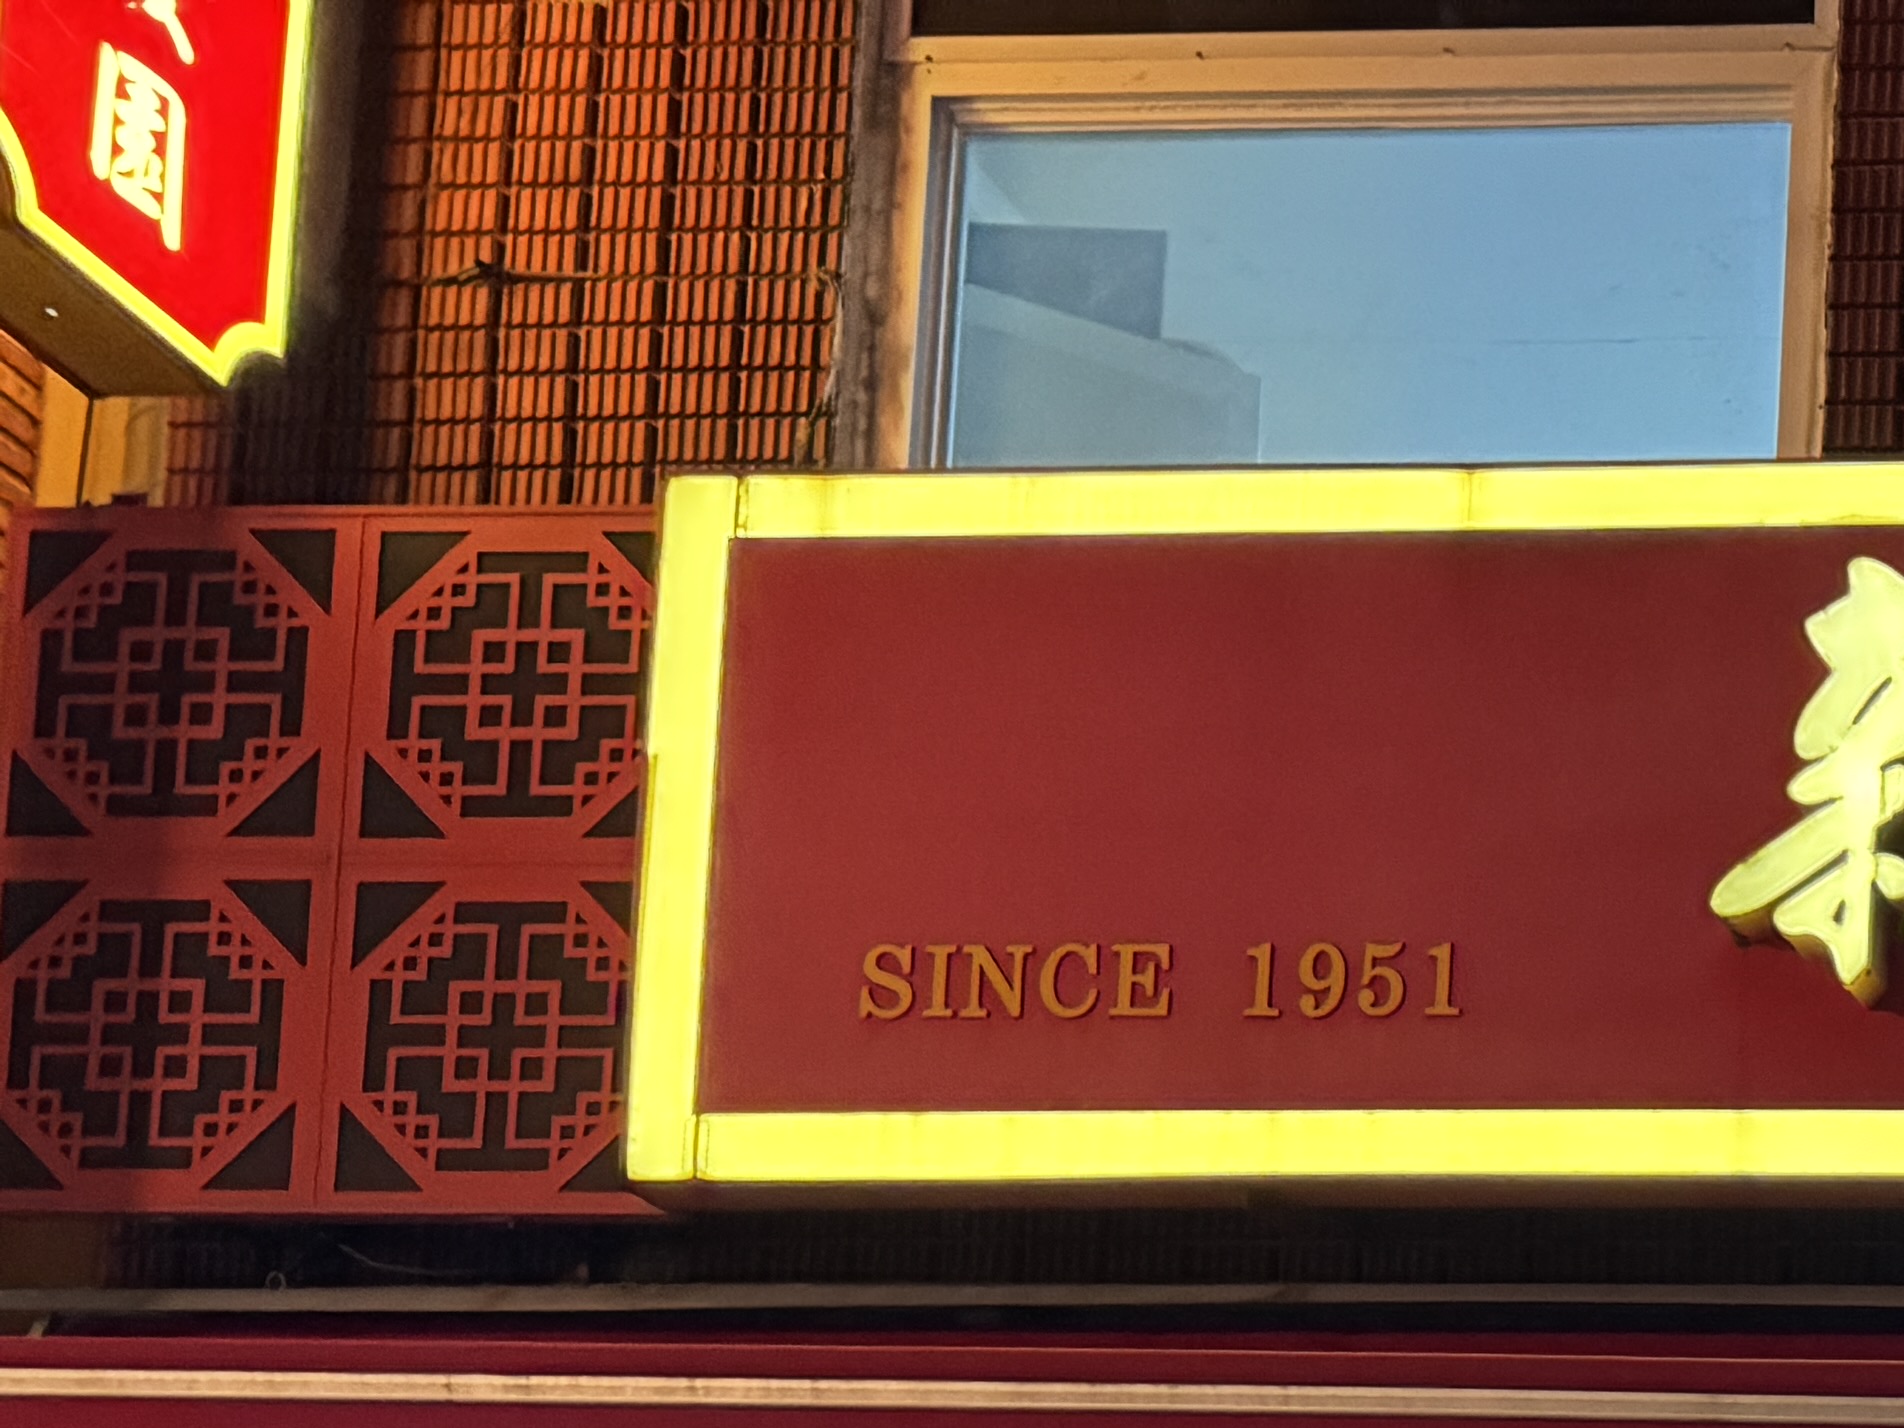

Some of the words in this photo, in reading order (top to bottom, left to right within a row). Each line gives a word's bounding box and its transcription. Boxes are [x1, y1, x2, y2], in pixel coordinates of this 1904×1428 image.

[90, 0, 196, 252] 園
[859, 943, 1175, 1020] SINCE
[1243, 942, 1462, 1019] 1951
